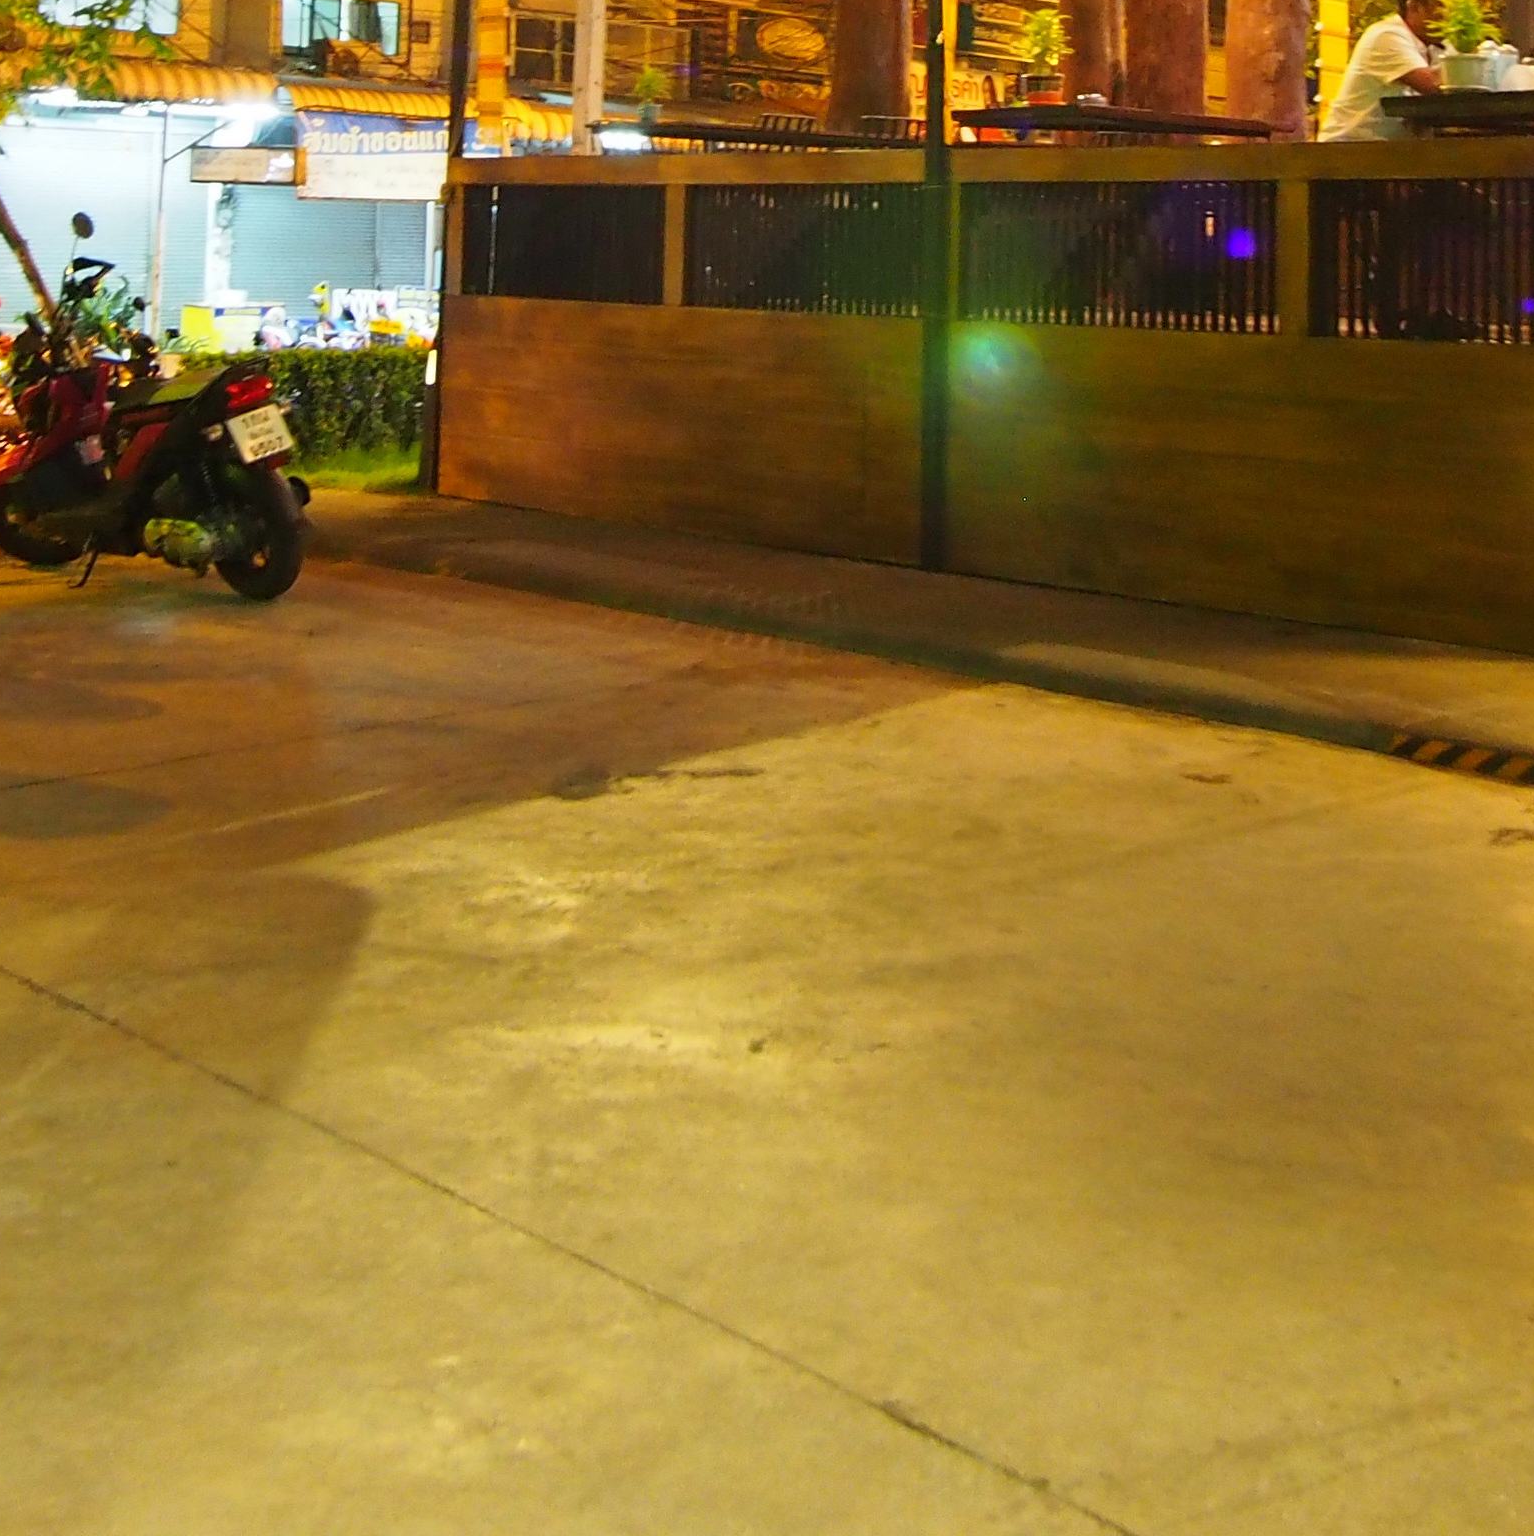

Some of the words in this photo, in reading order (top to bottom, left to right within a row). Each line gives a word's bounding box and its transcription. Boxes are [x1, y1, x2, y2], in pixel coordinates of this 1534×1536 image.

[303, 117, 451, 153] ส้มตำขอนแก่
